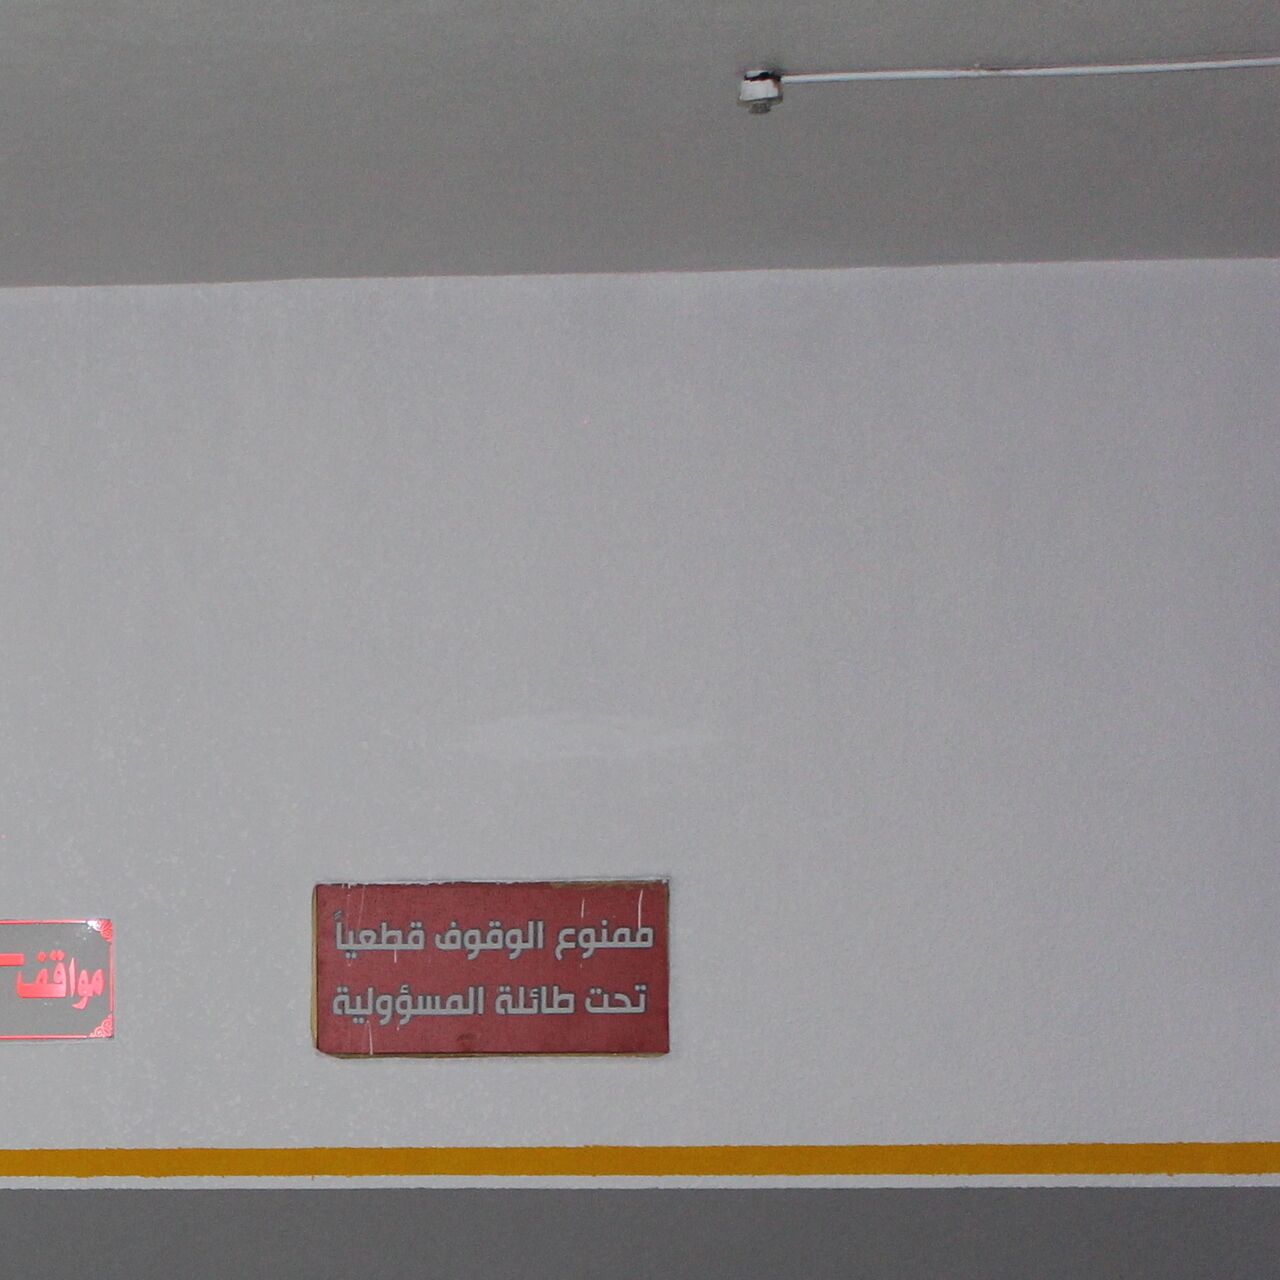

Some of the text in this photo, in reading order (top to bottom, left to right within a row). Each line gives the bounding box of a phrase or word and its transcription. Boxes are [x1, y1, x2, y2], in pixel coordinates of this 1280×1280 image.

[434, 921, 545, 960] الوقوف
[555, 919, 654, 959] ممنوع
[16, 951, 105, 1010] مواقف
[332, 984, 647, 1025] تحت طائلة المسؤولية
